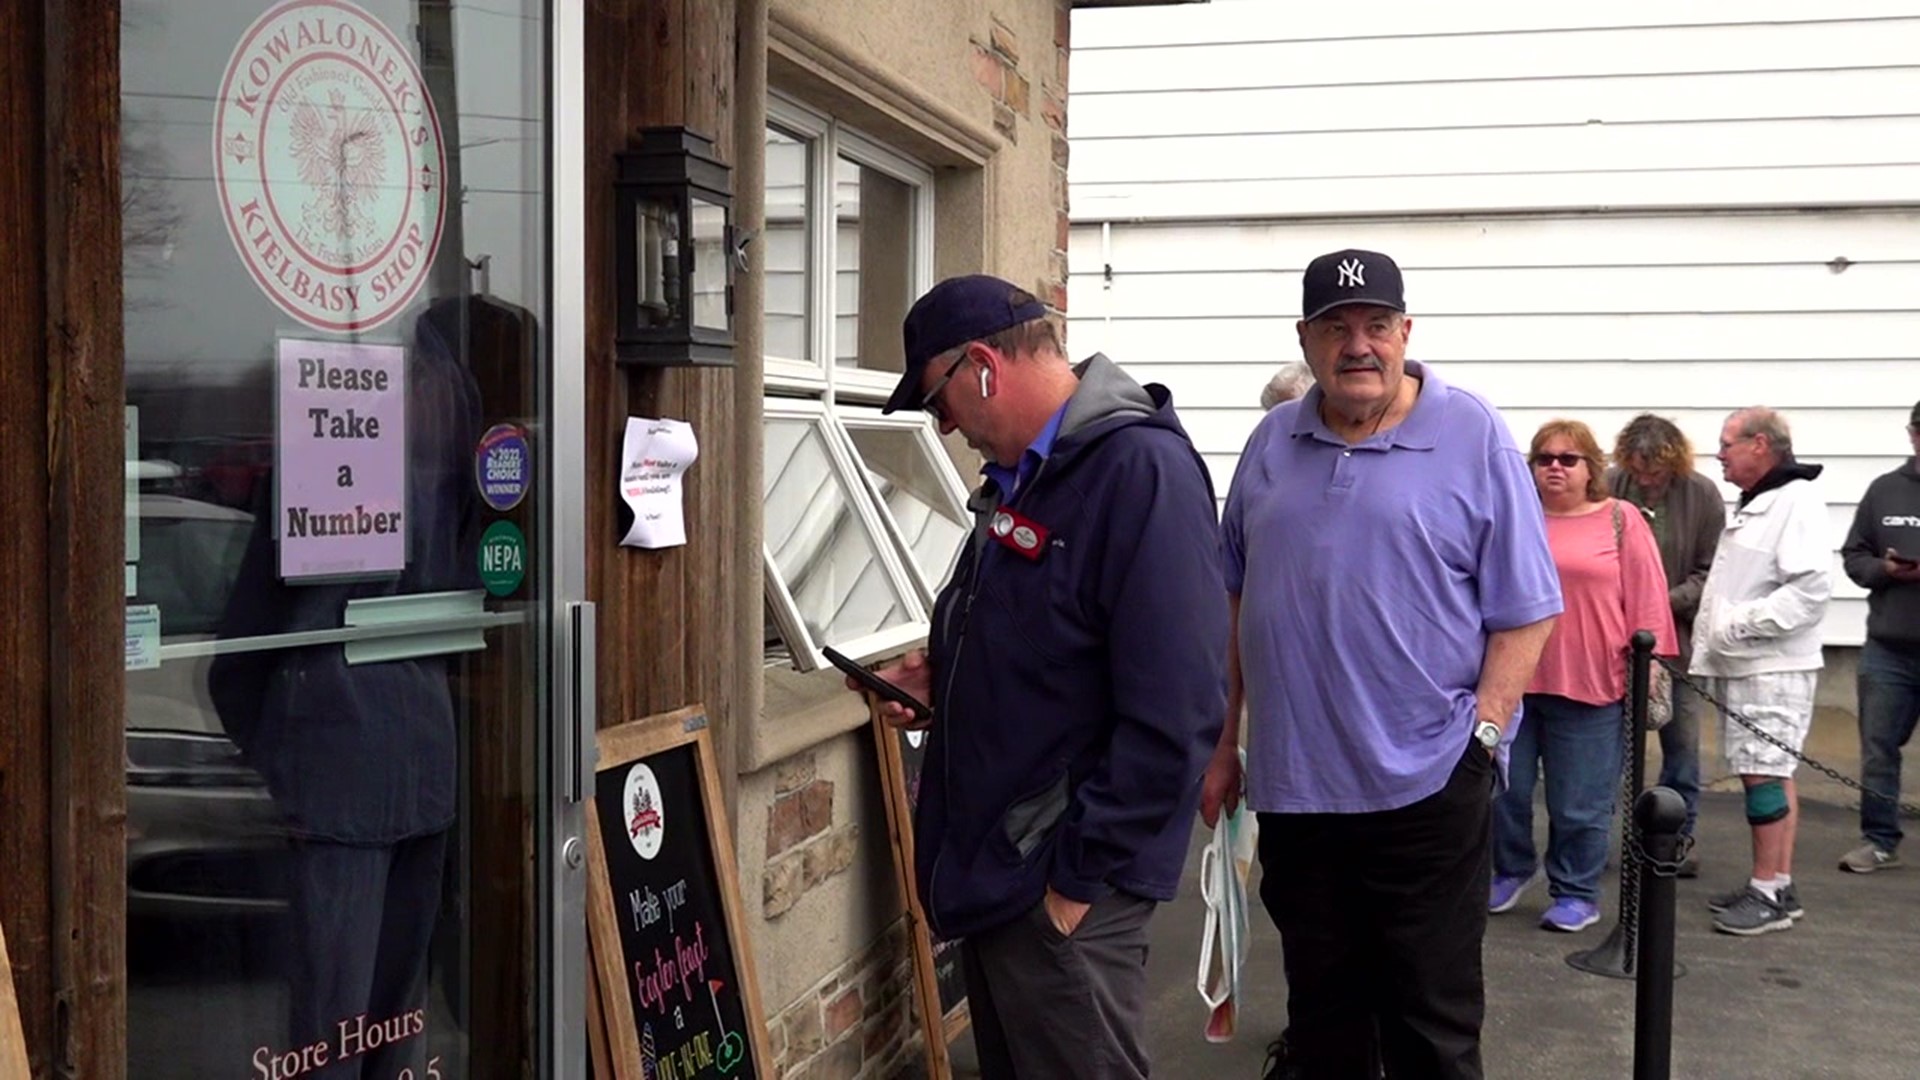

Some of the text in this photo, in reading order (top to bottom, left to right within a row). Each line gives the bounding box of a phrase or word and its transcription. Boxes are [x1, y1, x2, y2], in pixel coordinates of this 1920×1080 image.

[236, 18, 430, 147] KOWALONEK'S
[239, 198, 425, 313] KIELBASY SHOP
[1337, 258, 1365, 287] NY
[297, 358, 389, 391] Please
[308, 408, 380, 439] Take
[336, 463, 354, 488] a
[486, 468, 522, 481] CHOICE
[486, 482, 522, 495] WINNER
[287, 505, 402, 538] Number
[483, 544, 523, 572] NEPA
[629, 879, 687, 933] Make your
[635, 948, 679, 1015] Easter
[673, 1005, 685, 1030] a
[252, 1009, 424, 1080] Store Hours
